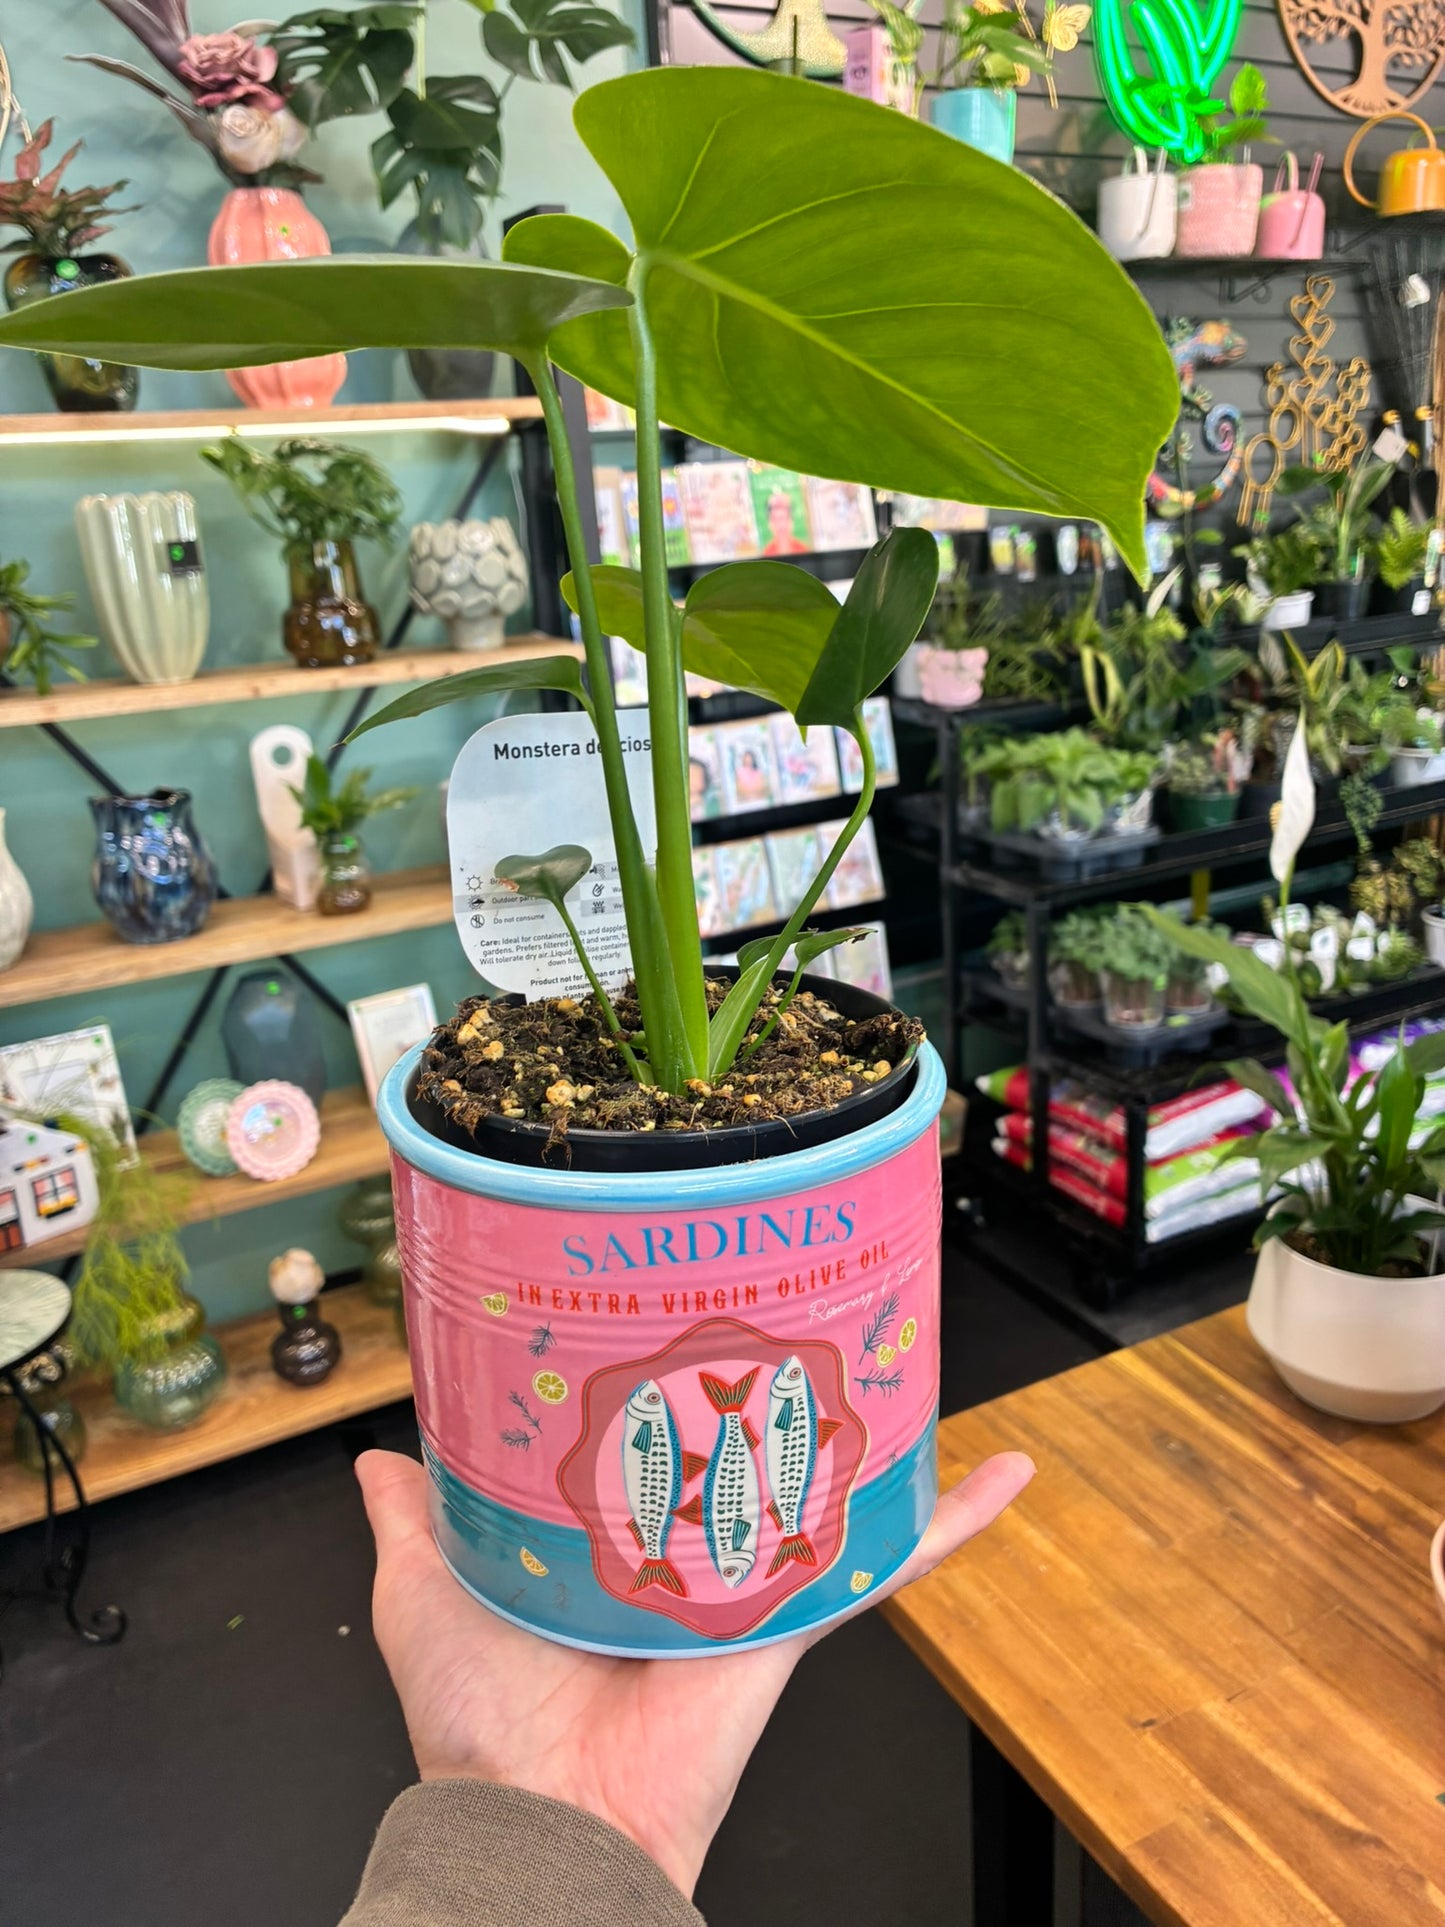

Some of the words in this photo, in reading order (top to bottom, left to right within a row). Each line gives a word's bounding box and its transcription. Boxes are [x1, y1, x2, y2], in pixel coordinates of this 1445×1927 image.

[493, 741, 581, 761] Monstera
[515, 914, 545, 922] consume
[480, 939, 500, 947] Care:
[502, 936, 520, 945] Ideal
[521, 935, 531, 943] for
[588, 927, 600, 935] and
[482, 947, 514, 957] gardens.
[515, 943, 542, 952] Prefers
[543, 940, 569, 949] filtered
[586, 936, 599, 944] and
[479, 957, 495, 965] Will
[495, 954, 524, 964] tolerate
[525, 952, 537, 961] dry
[547, 959, 567, 967] down
[530, 976, 559, 986] Product
[560, 974, 572, 983] not
[562, 1201, 856, 1276] SARDINES
[517, 1282, 542, 1306] IN
[552, 1288, 640, 1314] EXTRA
[662, 1284, 758, 1314] VIRGIN
[777, 1258, 846, 1298] OLIVE
[860, 1240, 889, 1269] OIL
[808, 1289, 875, 1325] Rosemary
